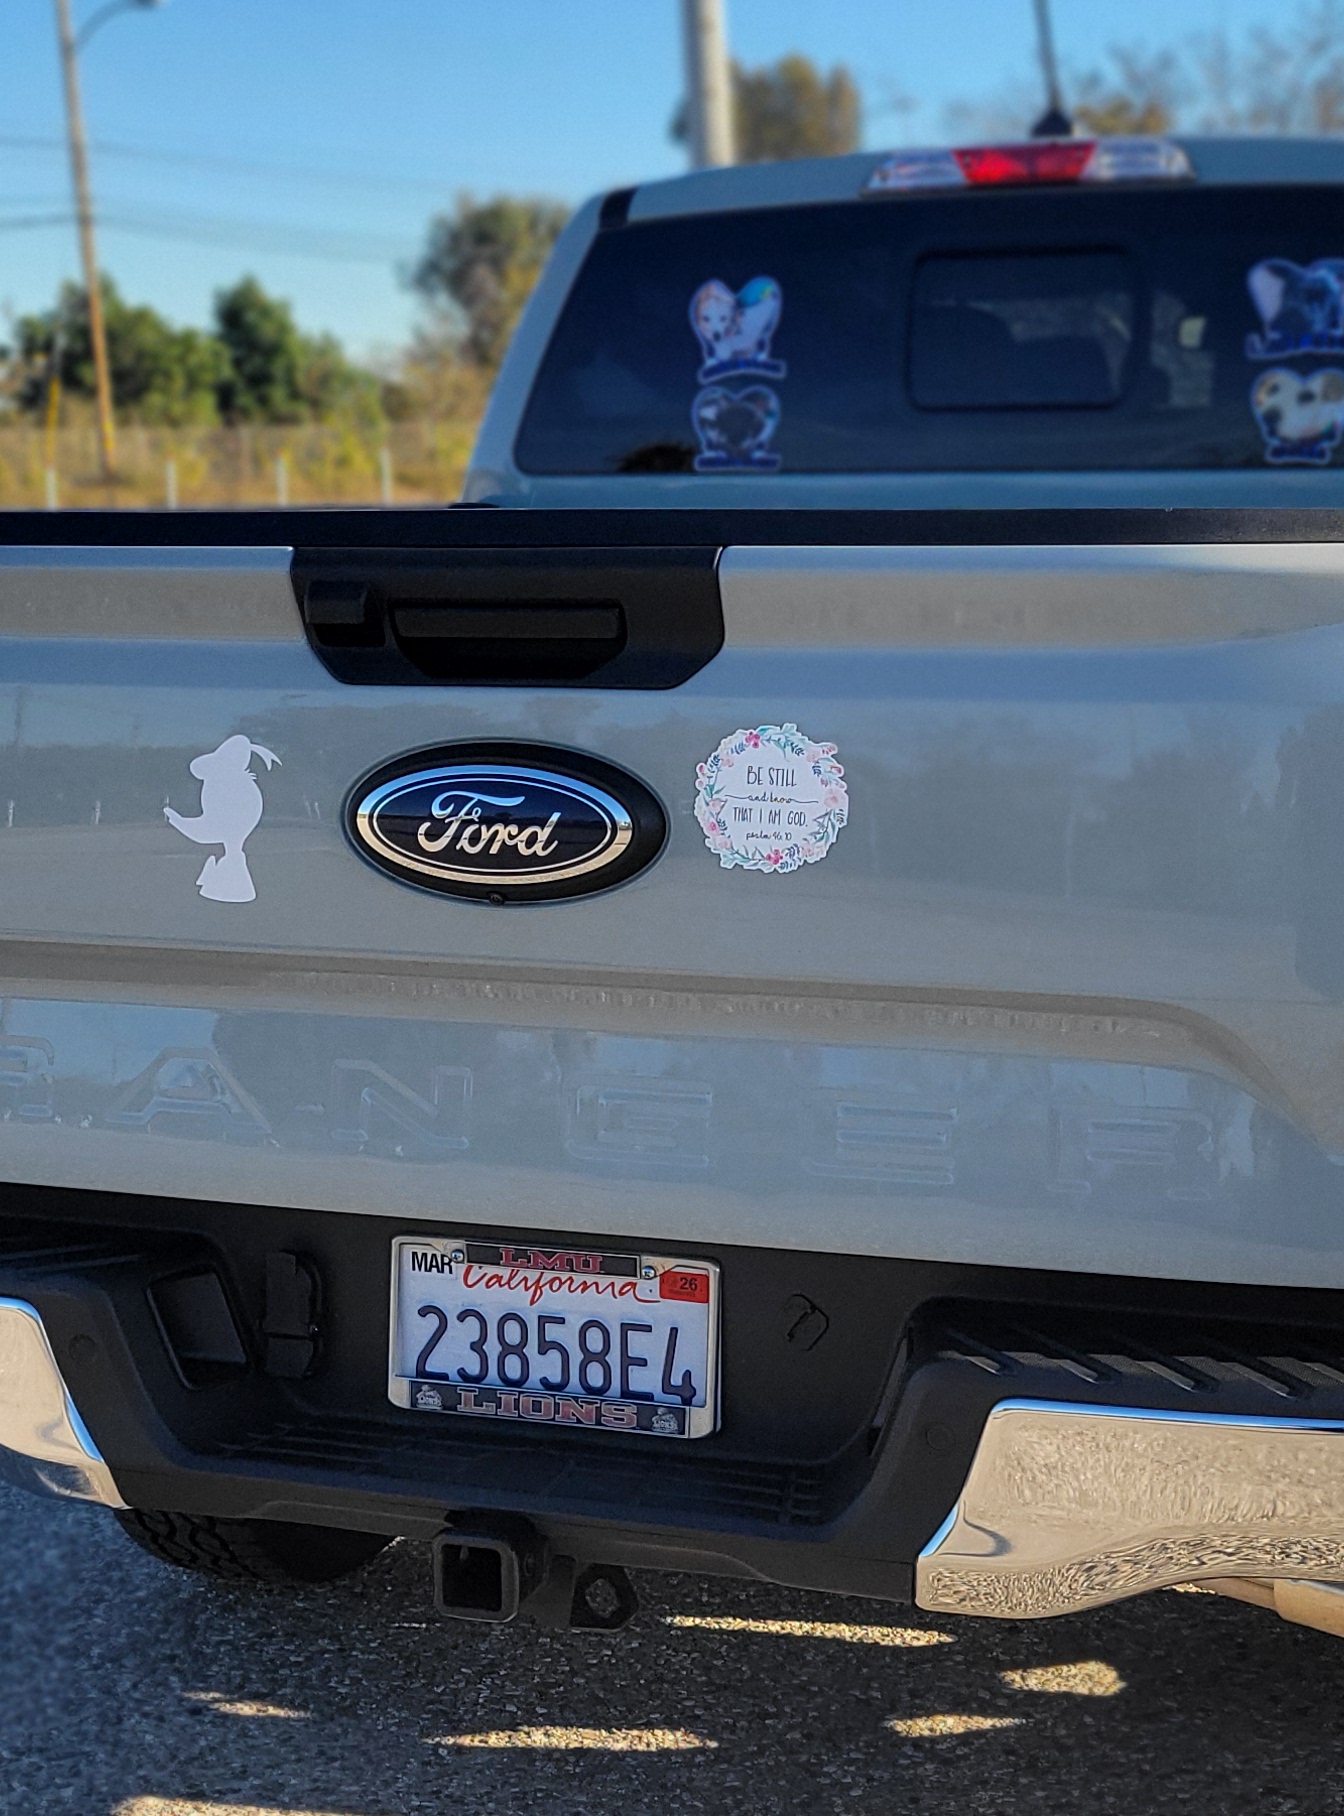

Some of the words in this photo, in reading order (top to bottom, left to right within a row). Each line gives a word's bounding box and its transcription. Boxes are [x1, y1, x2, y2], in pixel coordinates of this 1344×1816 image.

[747, 766, 763, 785] BE
[768, 767, 797, 787] STILL
[748, 791, 768, 802] and
[770, 791, 793, 803] know
[418, 790, 562, 857] Ford
[733, 806, 754, 823] THAT
[759, 807, 763, 824] I
[768, 809, 781, 825] AM
[787, 811, 808, 827] GOD.
[411, 1251, 453, 1275] MAR
[500, 1248, 604, 1274] LMU
[462, 1265, 660, 1305] California
[679, 1277, 698, 1291] 26
[415, 1304, 697, 1405] 23858E4
[457, 1387, 638, 1429] LIONS
